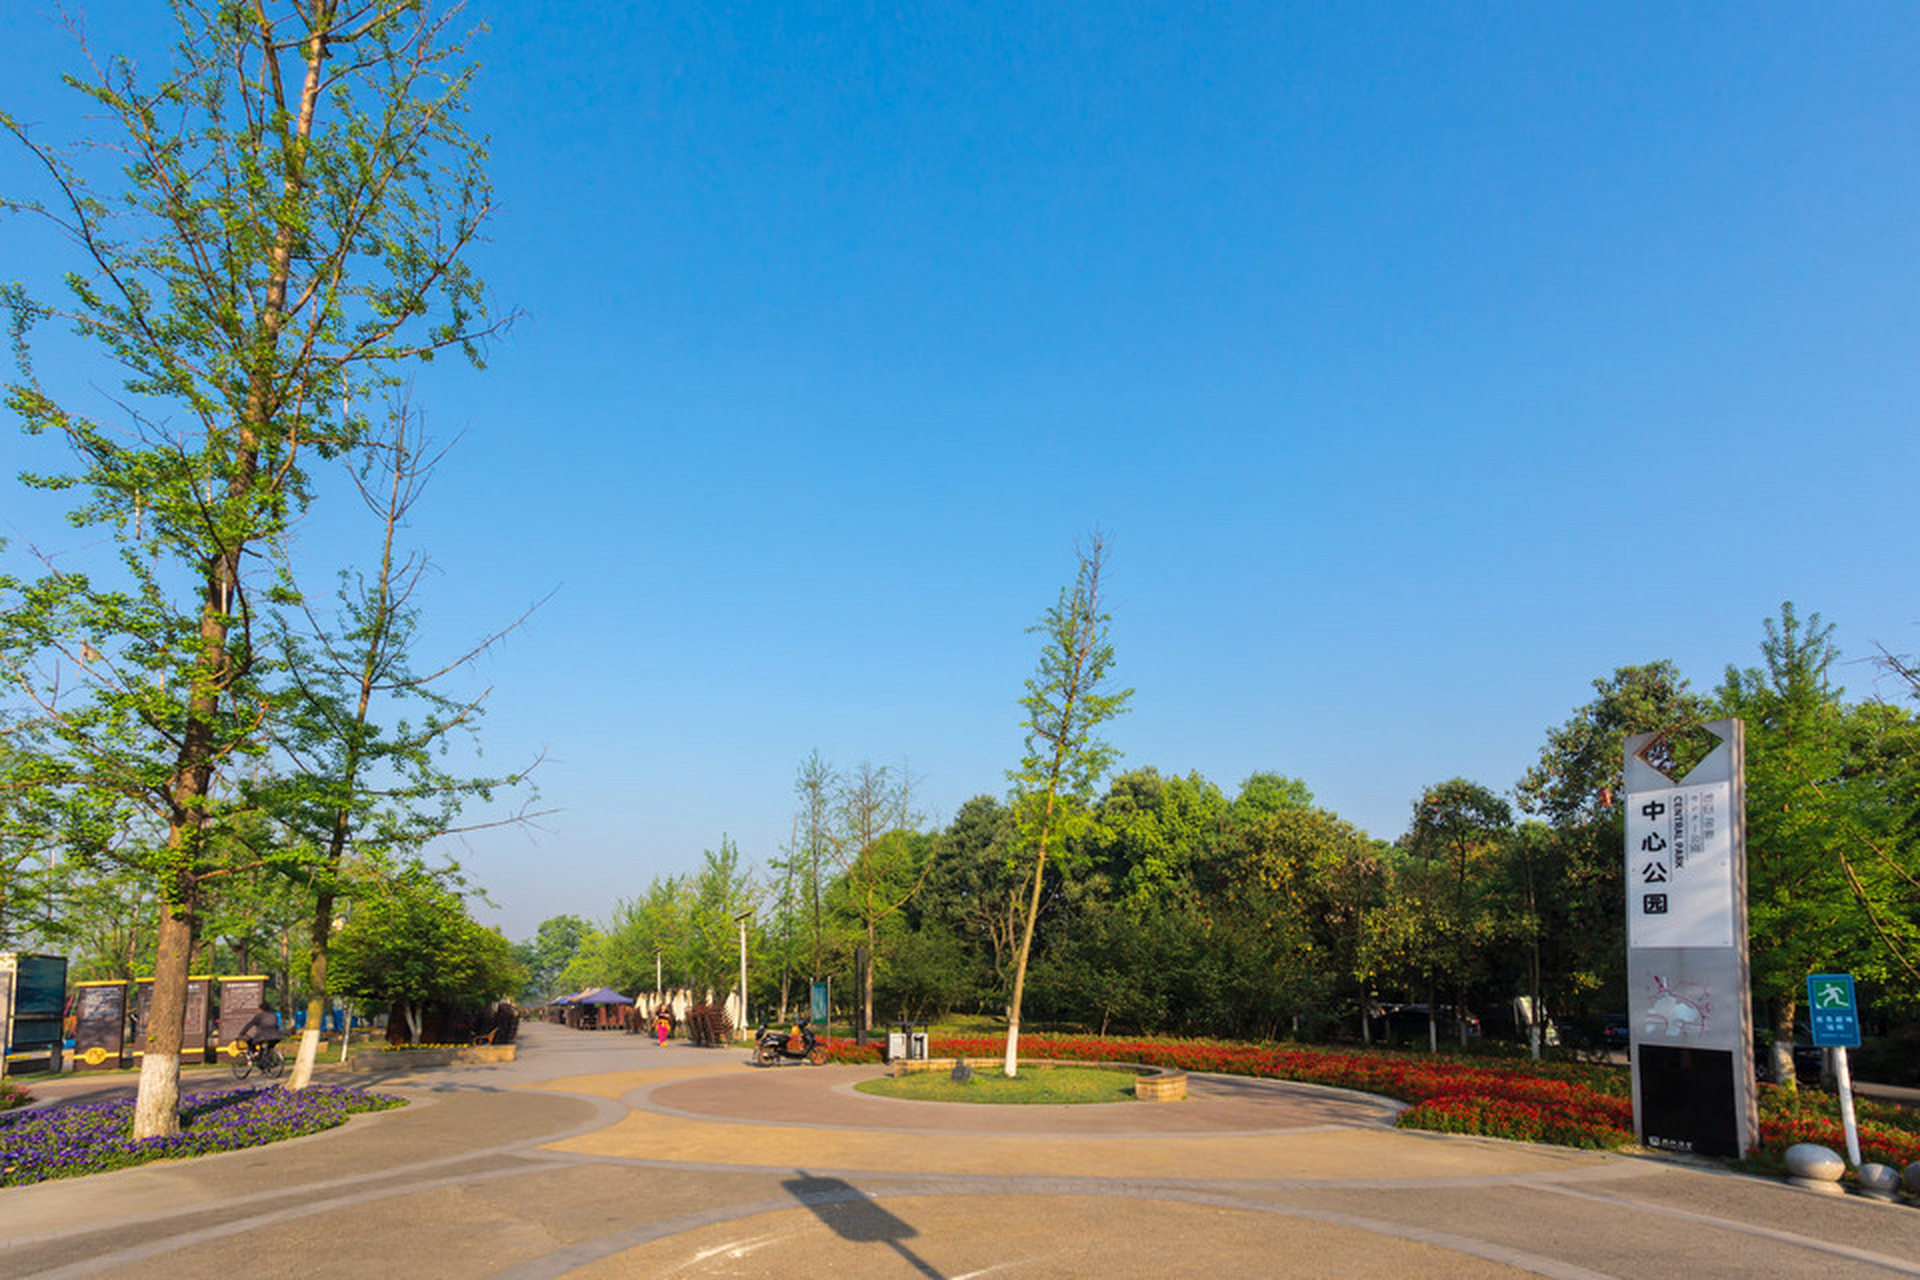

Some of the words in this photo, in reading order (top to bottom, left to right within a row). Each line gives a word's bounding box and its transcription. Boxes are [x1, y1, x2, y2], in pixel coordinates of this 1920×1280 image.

[1673, 795, 1684, 840] CENTRAL
[1641, 800, 1668, 915] 中心公园
[1674, 842, 1685, 869] PARK
